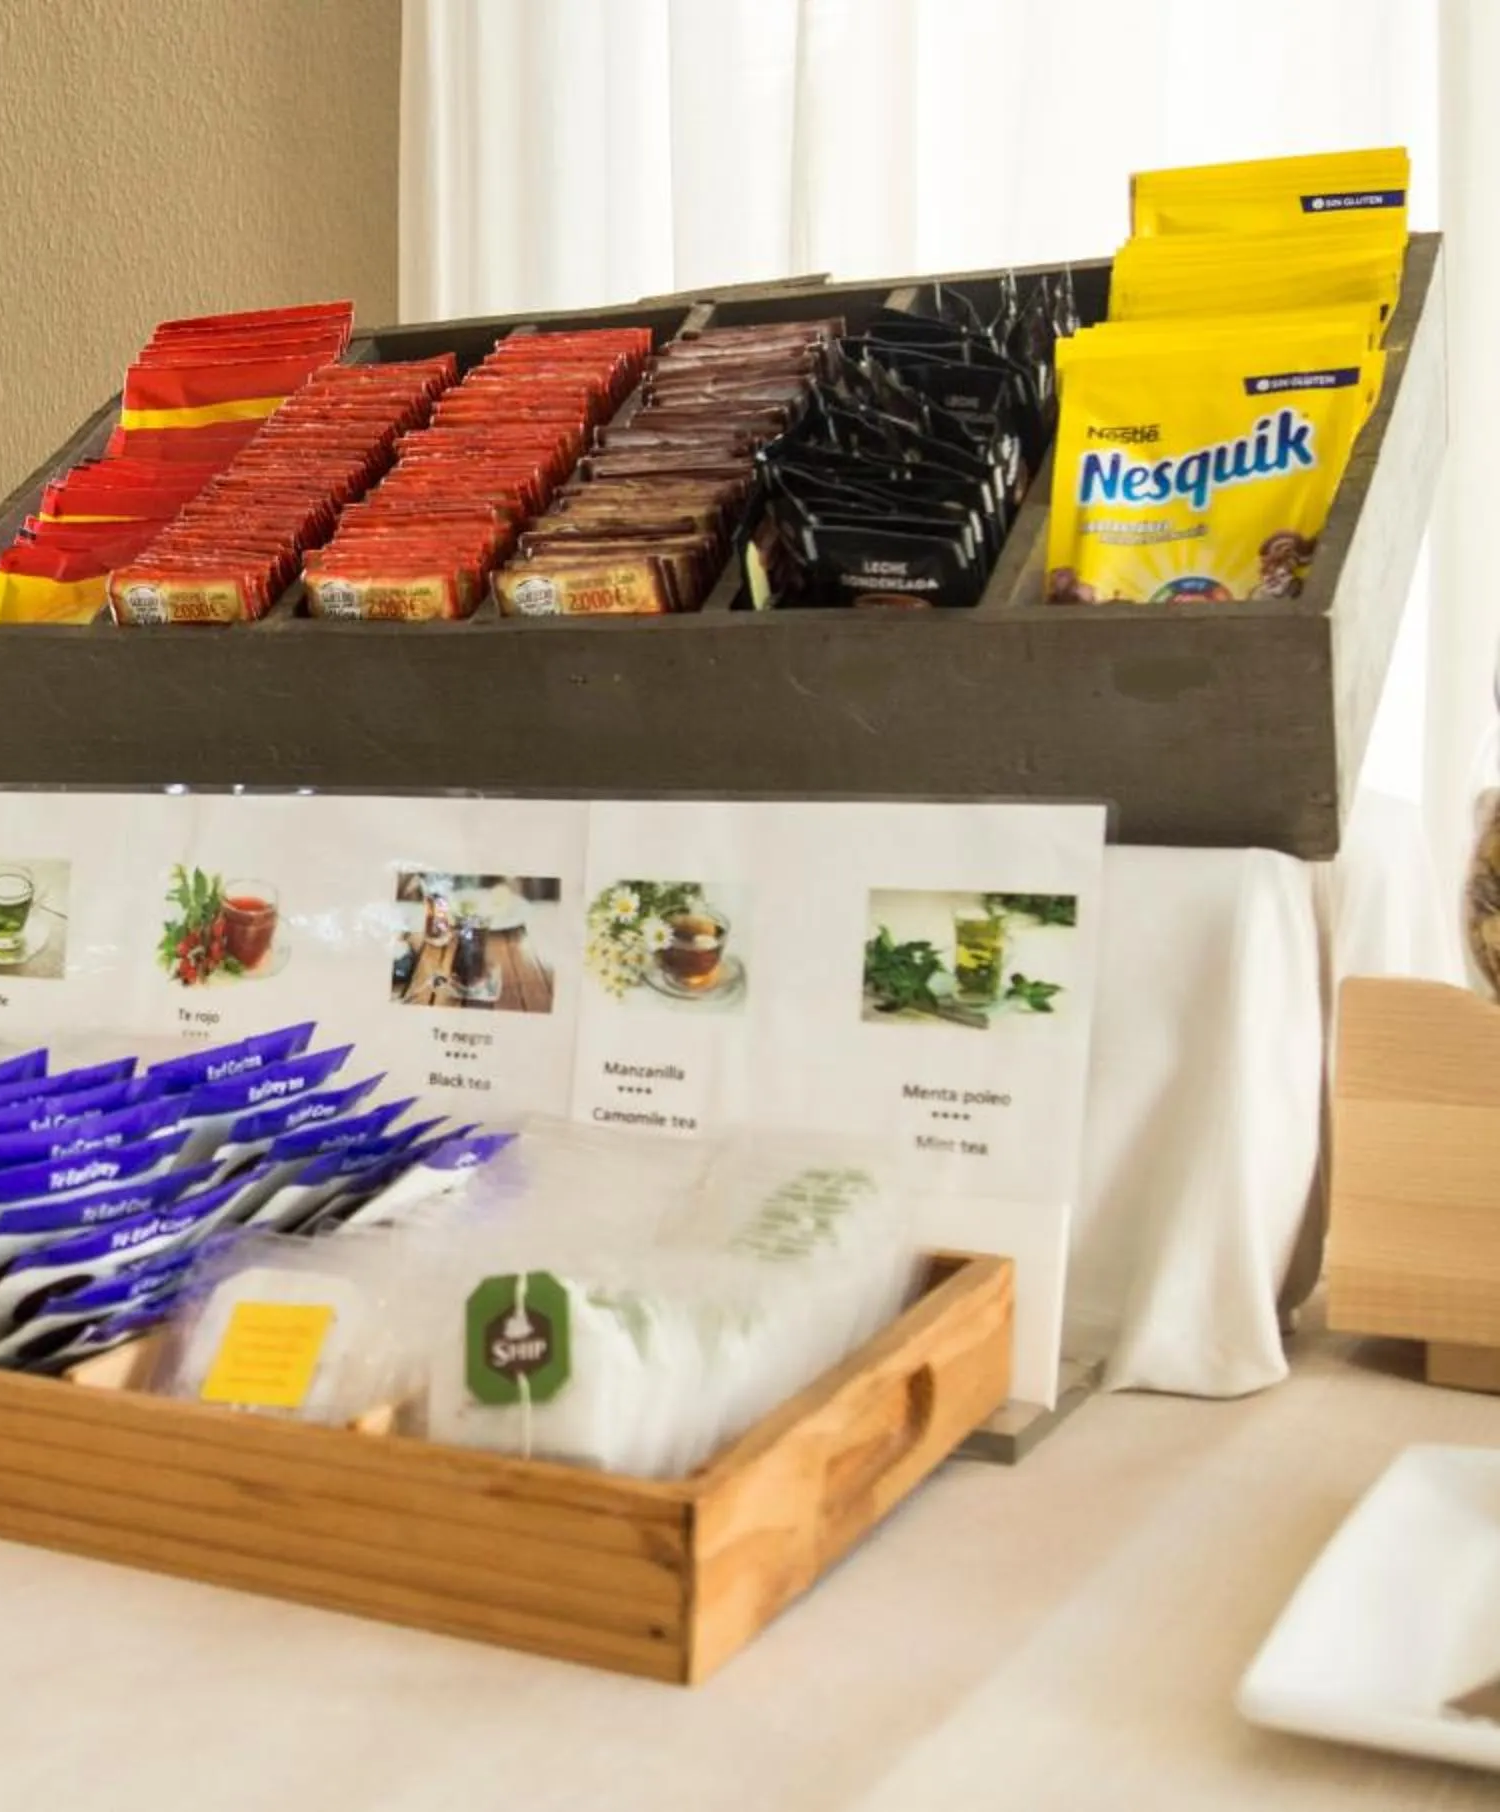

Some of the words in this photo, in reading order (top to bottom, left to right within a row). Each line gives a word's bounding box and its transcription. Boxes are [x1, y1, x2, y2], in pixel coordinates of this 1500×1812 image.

[1080, 409, 1314, 509] Nesquik
[862, 560, 908, 575] LECHE
[428, 1071, 465, 1089] Black
[467, 1076, 492, 1092] tea
[603, 1060, 685, 1082] Manzanilla
[902, 1083, 958, 1103] Menta
[962, 1088, 1013, 1108] poleo
[593, 1106, 667, 1128] Camomile
[671, 1114, 698, 1131] tea
